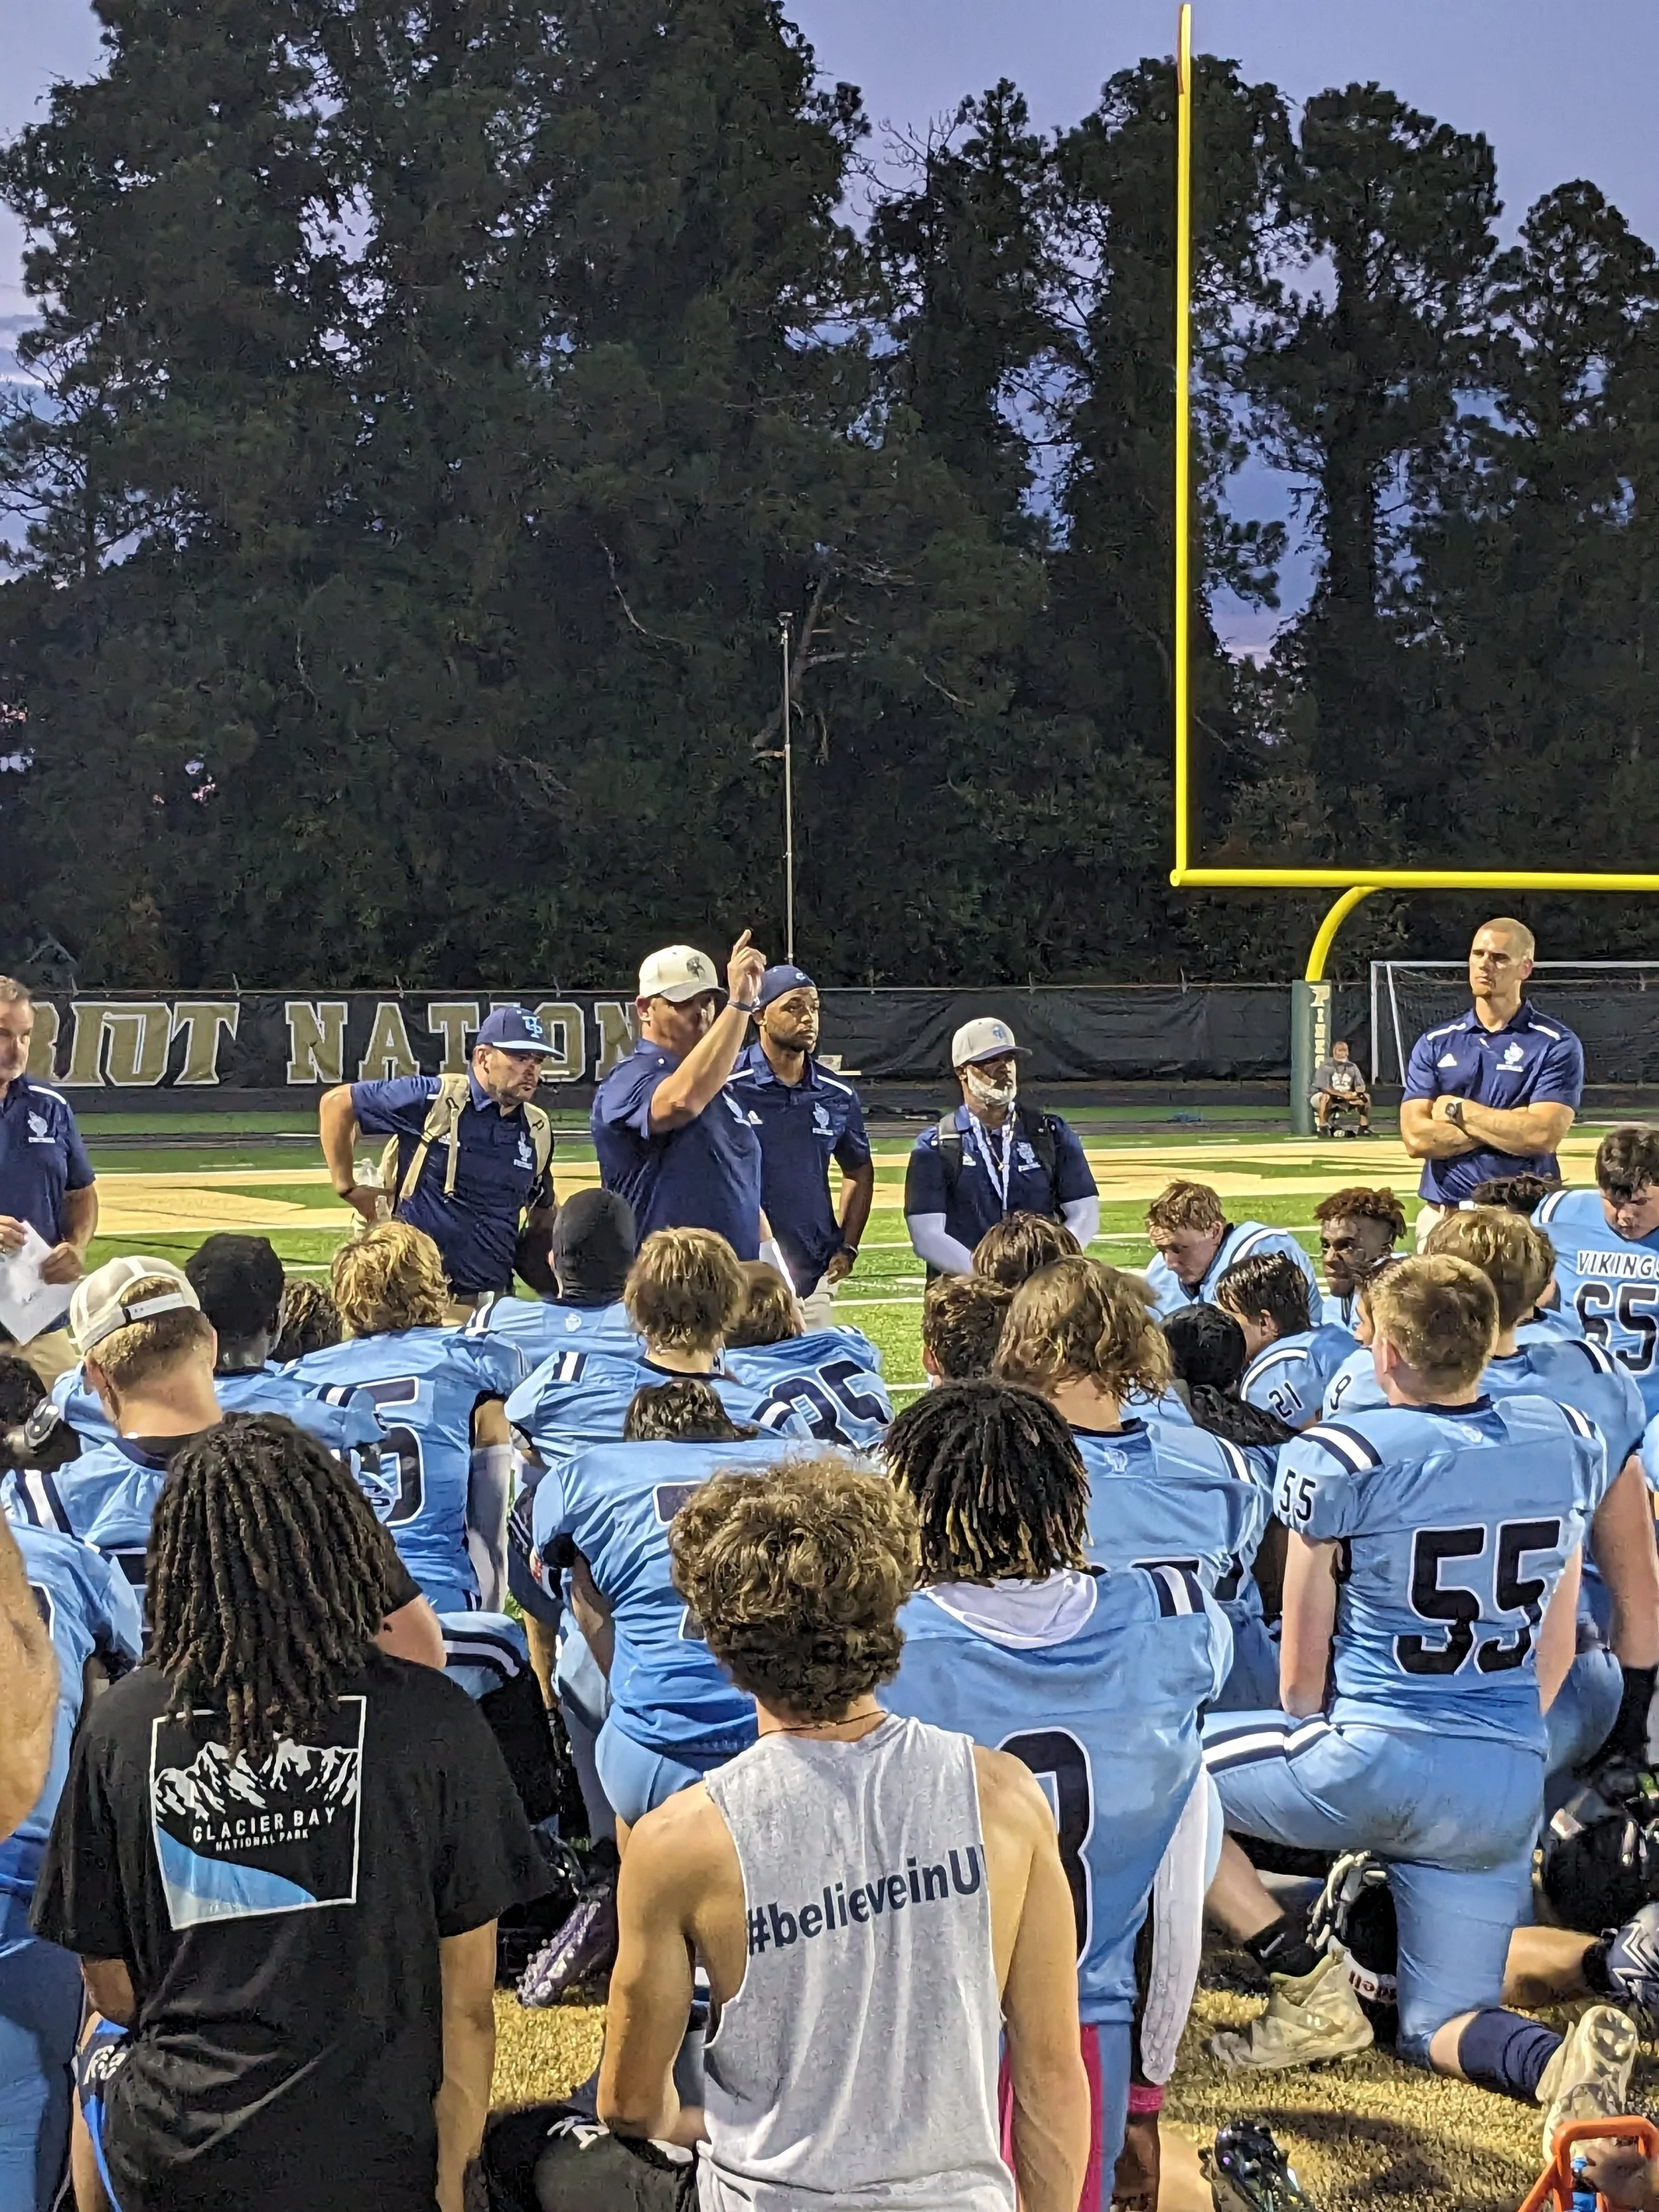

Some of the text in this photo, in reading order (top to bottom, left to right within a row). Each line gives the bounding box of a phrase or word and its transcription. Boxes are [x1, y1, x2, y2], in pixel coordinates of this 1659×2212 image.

[285, 1001, 642, 1084] NATON
[1573, 1281, 1659, 1374] 65
[1267, 1379, 1305, 1420] 21
[1329, 1374, 1352, 1411] 9
[1277, 1466, 1317, 1523] 55
[1393, 1516, 1562, 1676] 55
[192, 1806, 335, 1844] GLACIER BAY
[215, 1828, 309, 1852] NATIONAL PARK
[747, 1844, 984, 1956] #believeinU
